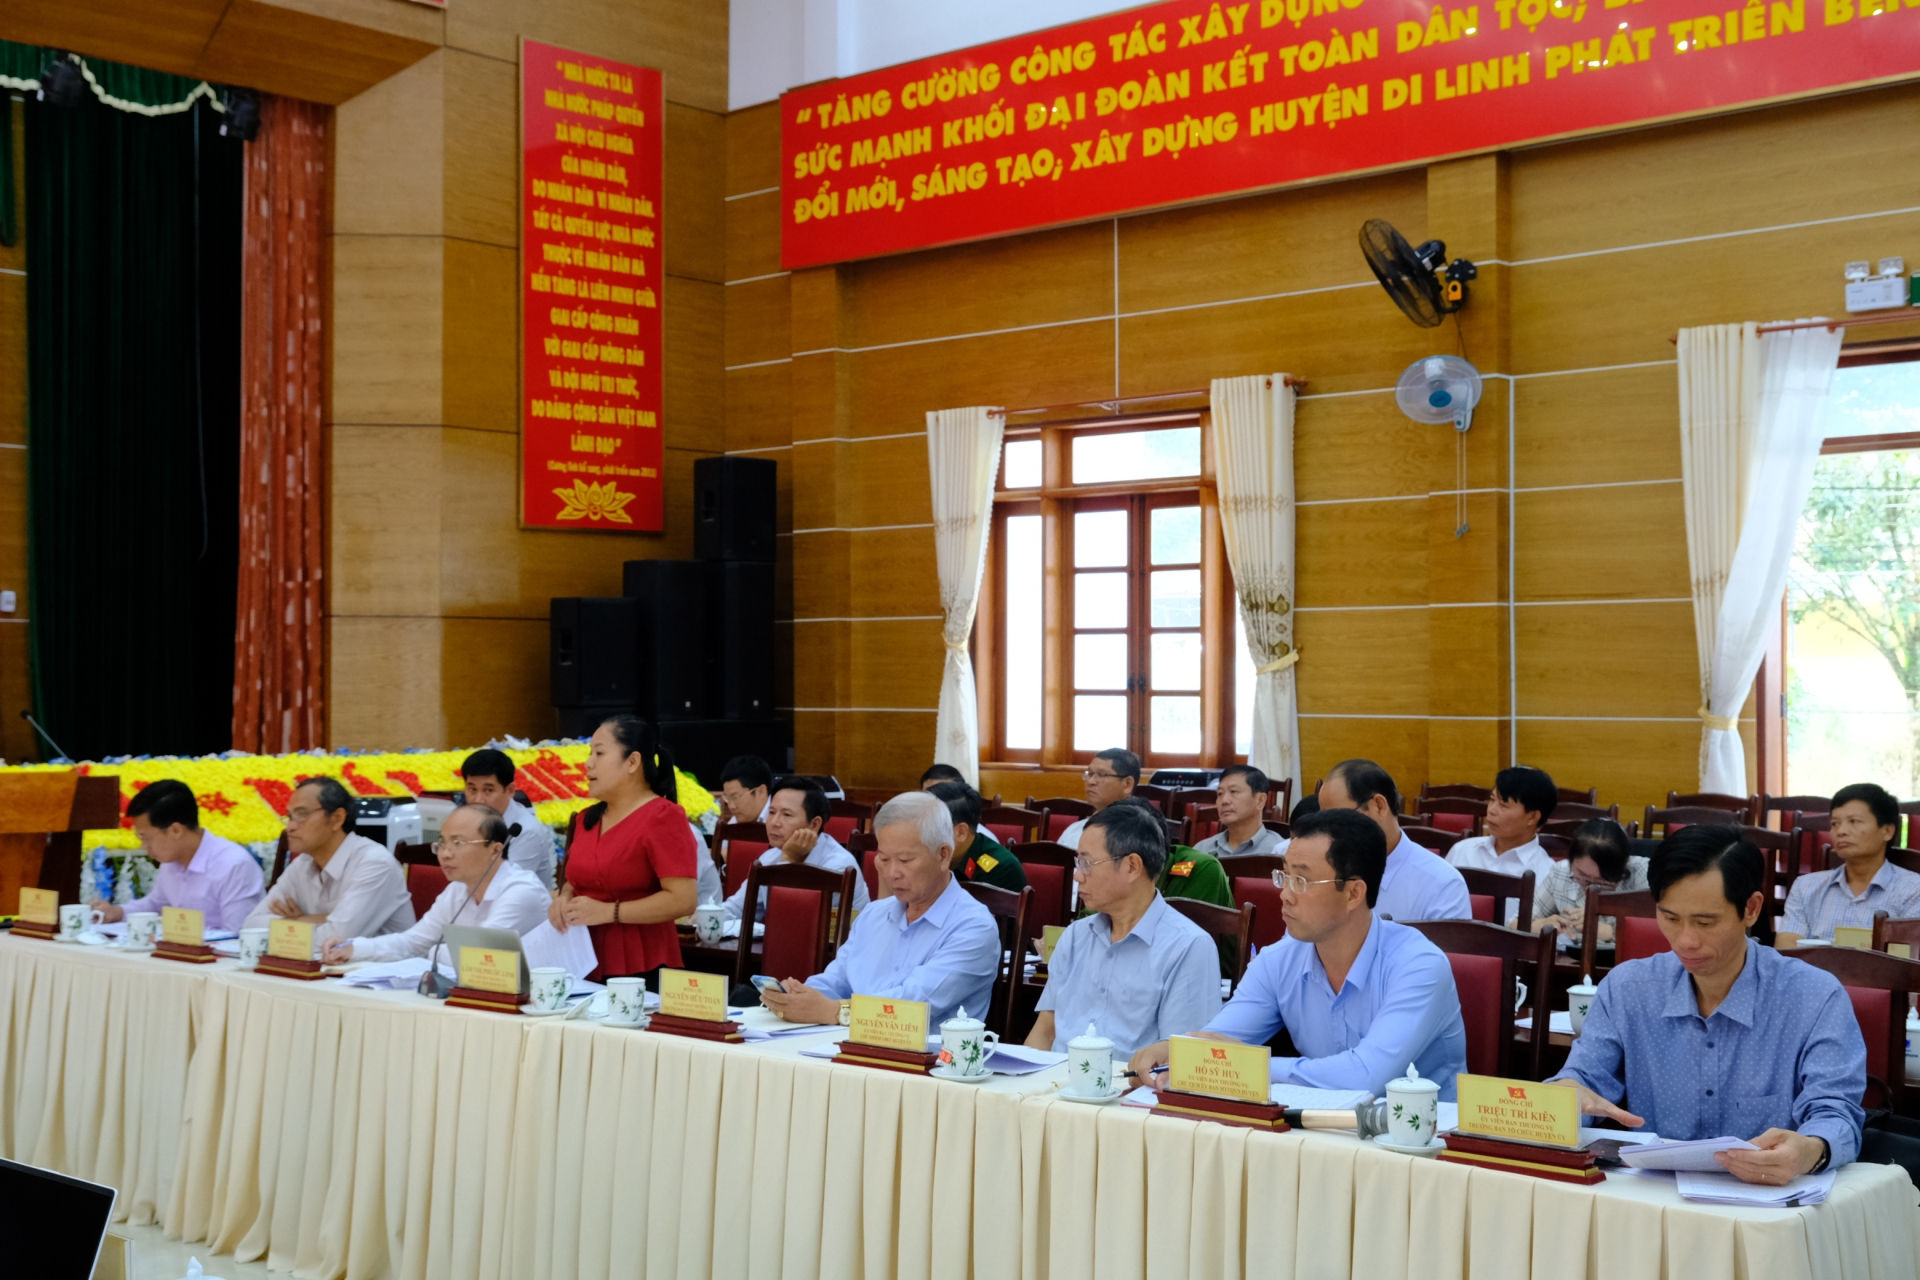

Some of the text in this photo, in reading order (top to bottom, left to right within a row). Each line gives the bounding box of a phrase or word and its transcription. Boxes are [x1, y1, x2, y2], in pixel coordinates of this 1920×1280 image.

[793, 142, 842, 179] SỨC
[850, 126, 932, 168] MẠNH
[943, 97, 1015, 149] KHỐI
[1025, 92, 1086, 131] ĐẠI
[1094, 69, 1190, 116] ĐOÀN
[1202, 44, 1269, 93] KẾT
[1279, 28, 1379, 77] TOÀN
[1396, 5, 1479, 54] DÂN
[793, 180, 839, 224] ĐỔI
[845, 175, 905, 213] MỚI,
[911, 163, 988, 201] SÁNG
[995, 148, 1063, 187] TẠO;
[1070, 129, 1133, 171] XÂY
[1143, 112, 1239, 160] DỰNG
[1250, 83, 1368, 137] HUYỆN
[1382, 73, 1422, 111] DI
[1435, 52, 1530, 101] LINH
[1545, 22, 1656, 80] PHÁT
[901, 63, 1001, 110] CƯỜNG
[1010, 42, 1096, 85] CÔNG
[1108, 20, 1166, 63] TÁC
[1178, 2, 1250, 48] XÂY
[1477, 1104, 1507, 1118] TRIỆU
